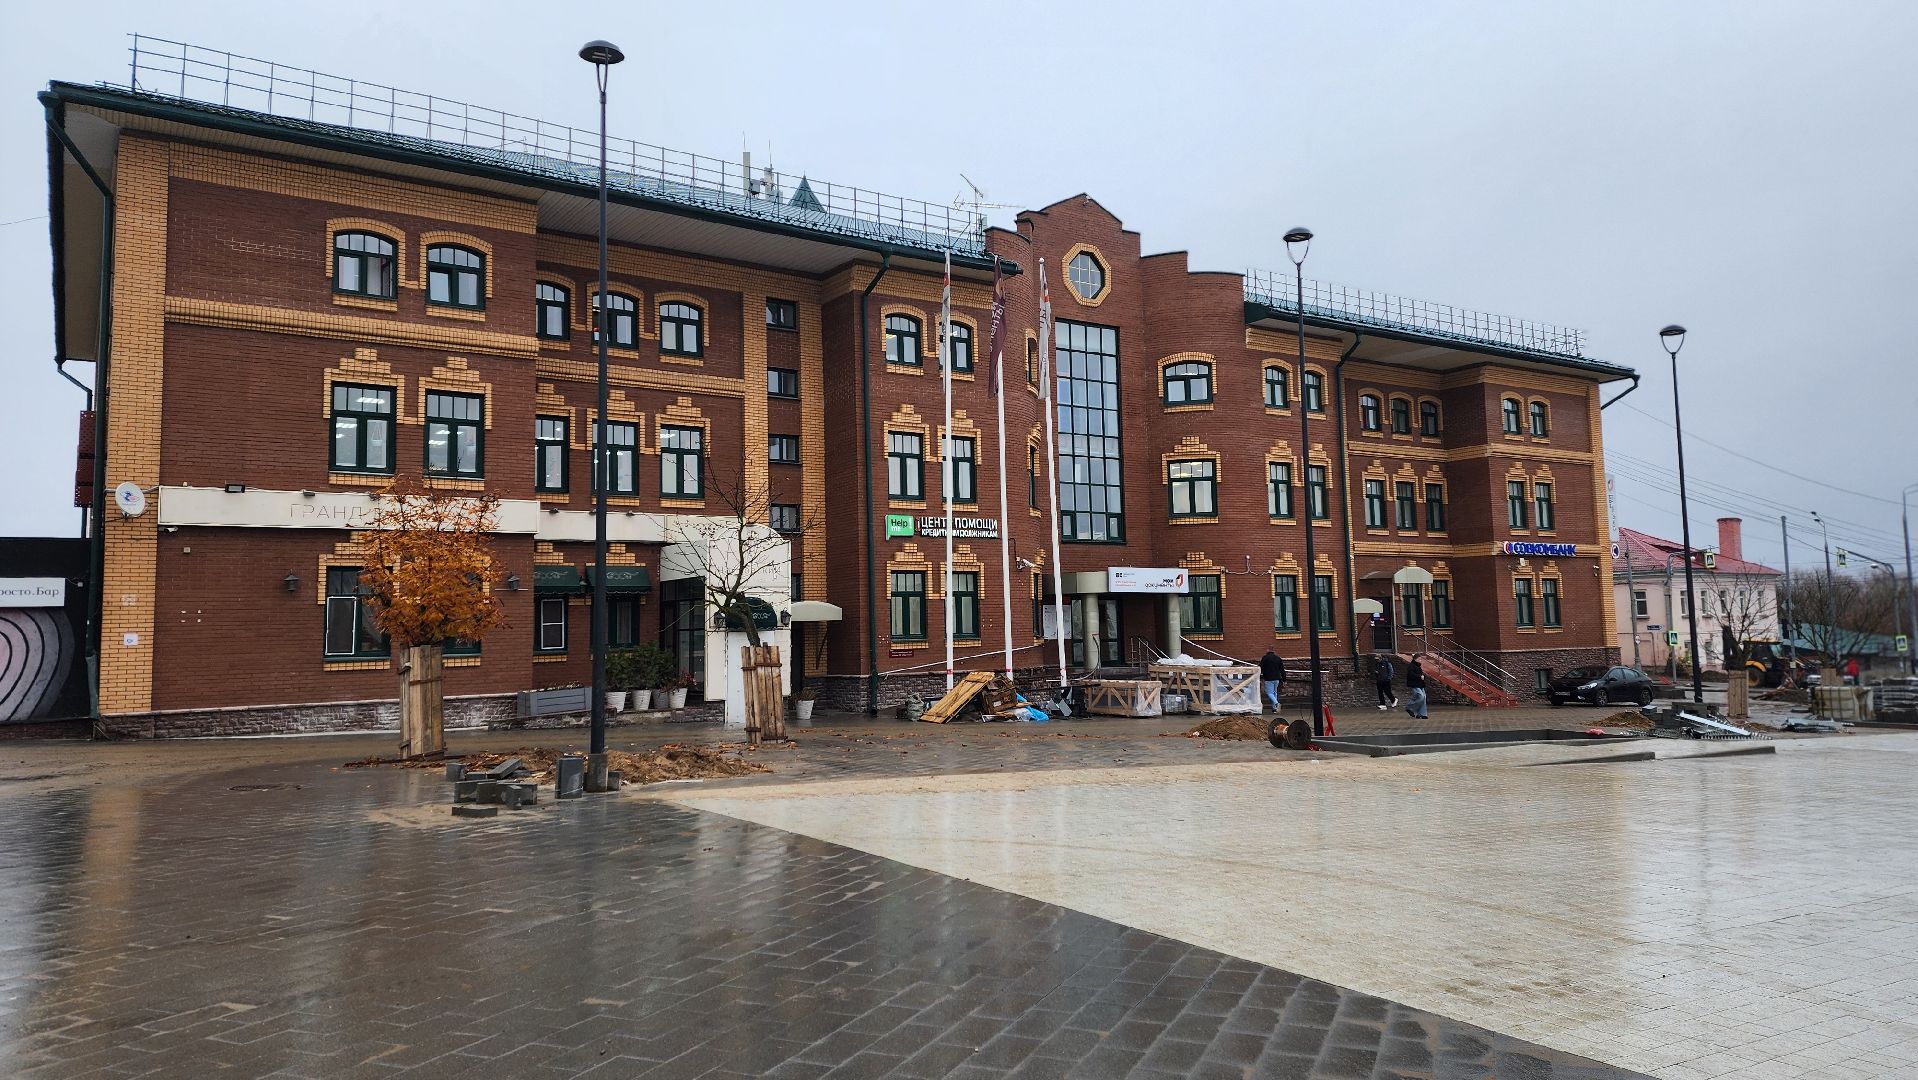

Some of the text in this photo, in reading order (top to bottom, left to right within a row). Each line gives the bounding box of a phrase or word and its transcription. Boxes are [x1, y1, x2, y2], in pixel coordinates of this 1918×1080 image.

[290, 503, 363, 521] ГРАНД
[921, 516, 998, 531] ЦЕНТ ПОМОЩИ
[1513, 542, 1577, 556] СОВКОМБАНК
